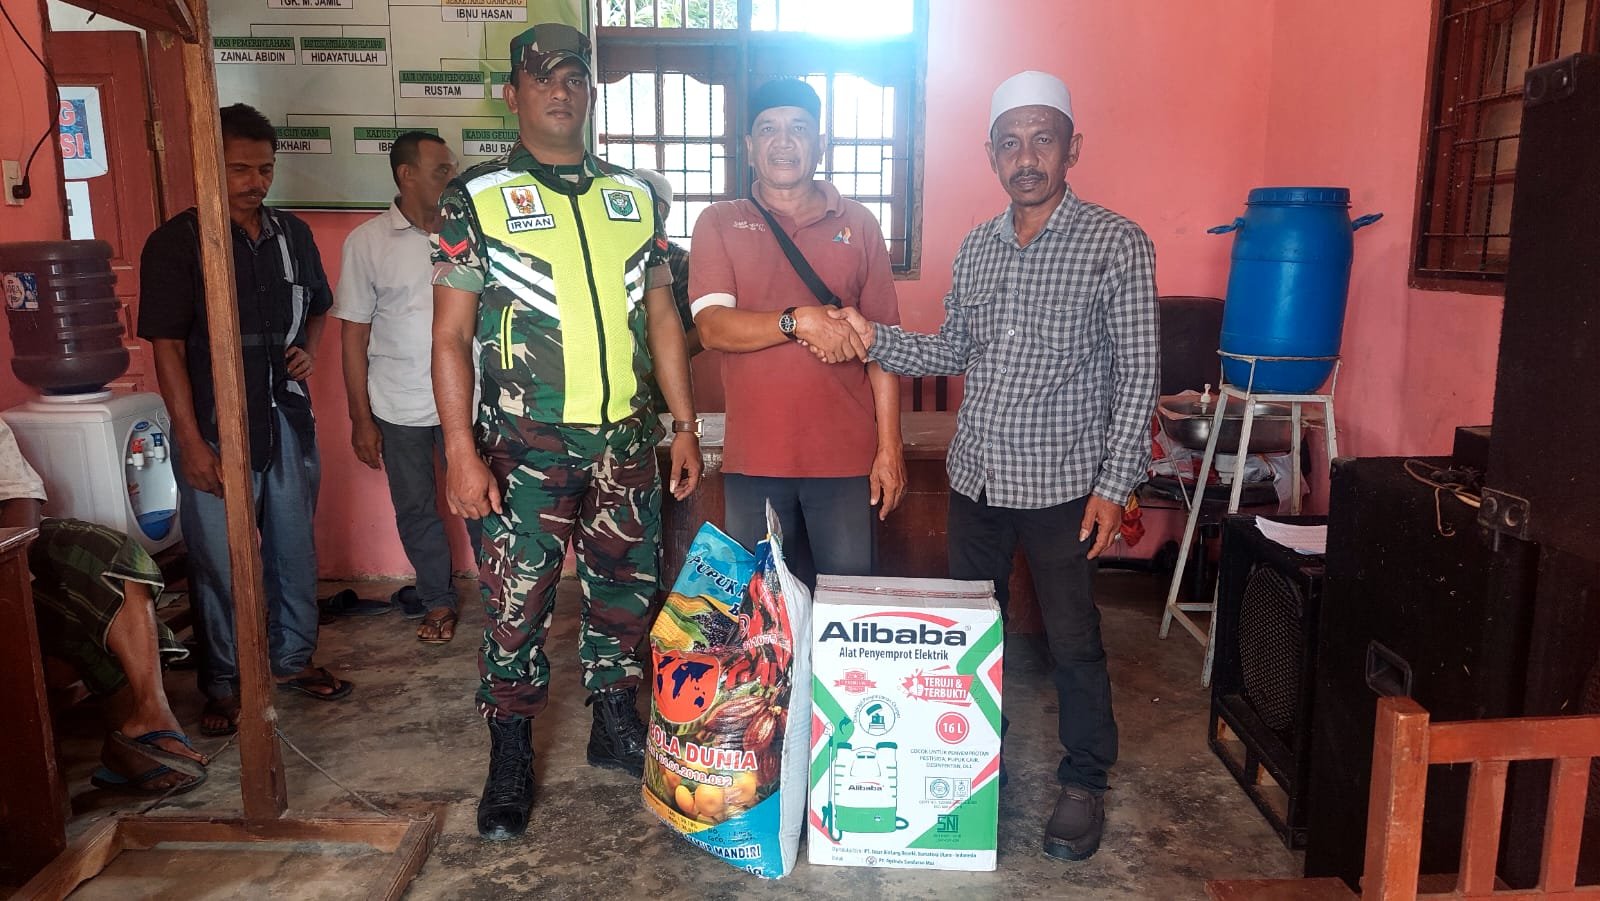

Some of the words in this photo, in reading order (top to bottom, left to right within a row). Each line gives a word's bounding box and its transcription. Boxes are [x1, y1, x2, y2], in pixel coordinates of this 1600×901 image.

[456, 8, 478, 19] IBNU
[480, 9, 512, 19] HASAN
[220, 51, 253, 61] ZAINAL
[255, 52, 286, 62] ABIDIN
[311, 53, 378, 63] HIDAYATULLAH
[424, 86, 462, 96] RUSTAM
[366, 129, 391, 138] KADUS
[466, 131, 490, 139] KADUS
[479, 143, 498, 153] ABU
[500, 144, 513, 153] BA
[510, 218, 552, 231] IRWAN
[818, 621, 967, 646] Alibaba
[839, 647, 857, 658] Alat
[858, 648, 912, 662] Penyemprot
[914, 649, 949, 661] Elektrik
[924, 677, 954, 688] TERUJI
[955, 678, 963, 689] &
[924, 687, 967, 700] TERBUKTI
[943, 722, 955, 733] 16
[957, 723, 963, 734] L
[648, 721, 682, 759] BOLA
[685, 741, 759, 771] DUNIA
[848, 784, 883, 792] Alibaba
[713, 843, 762, 860] MANDIRI
